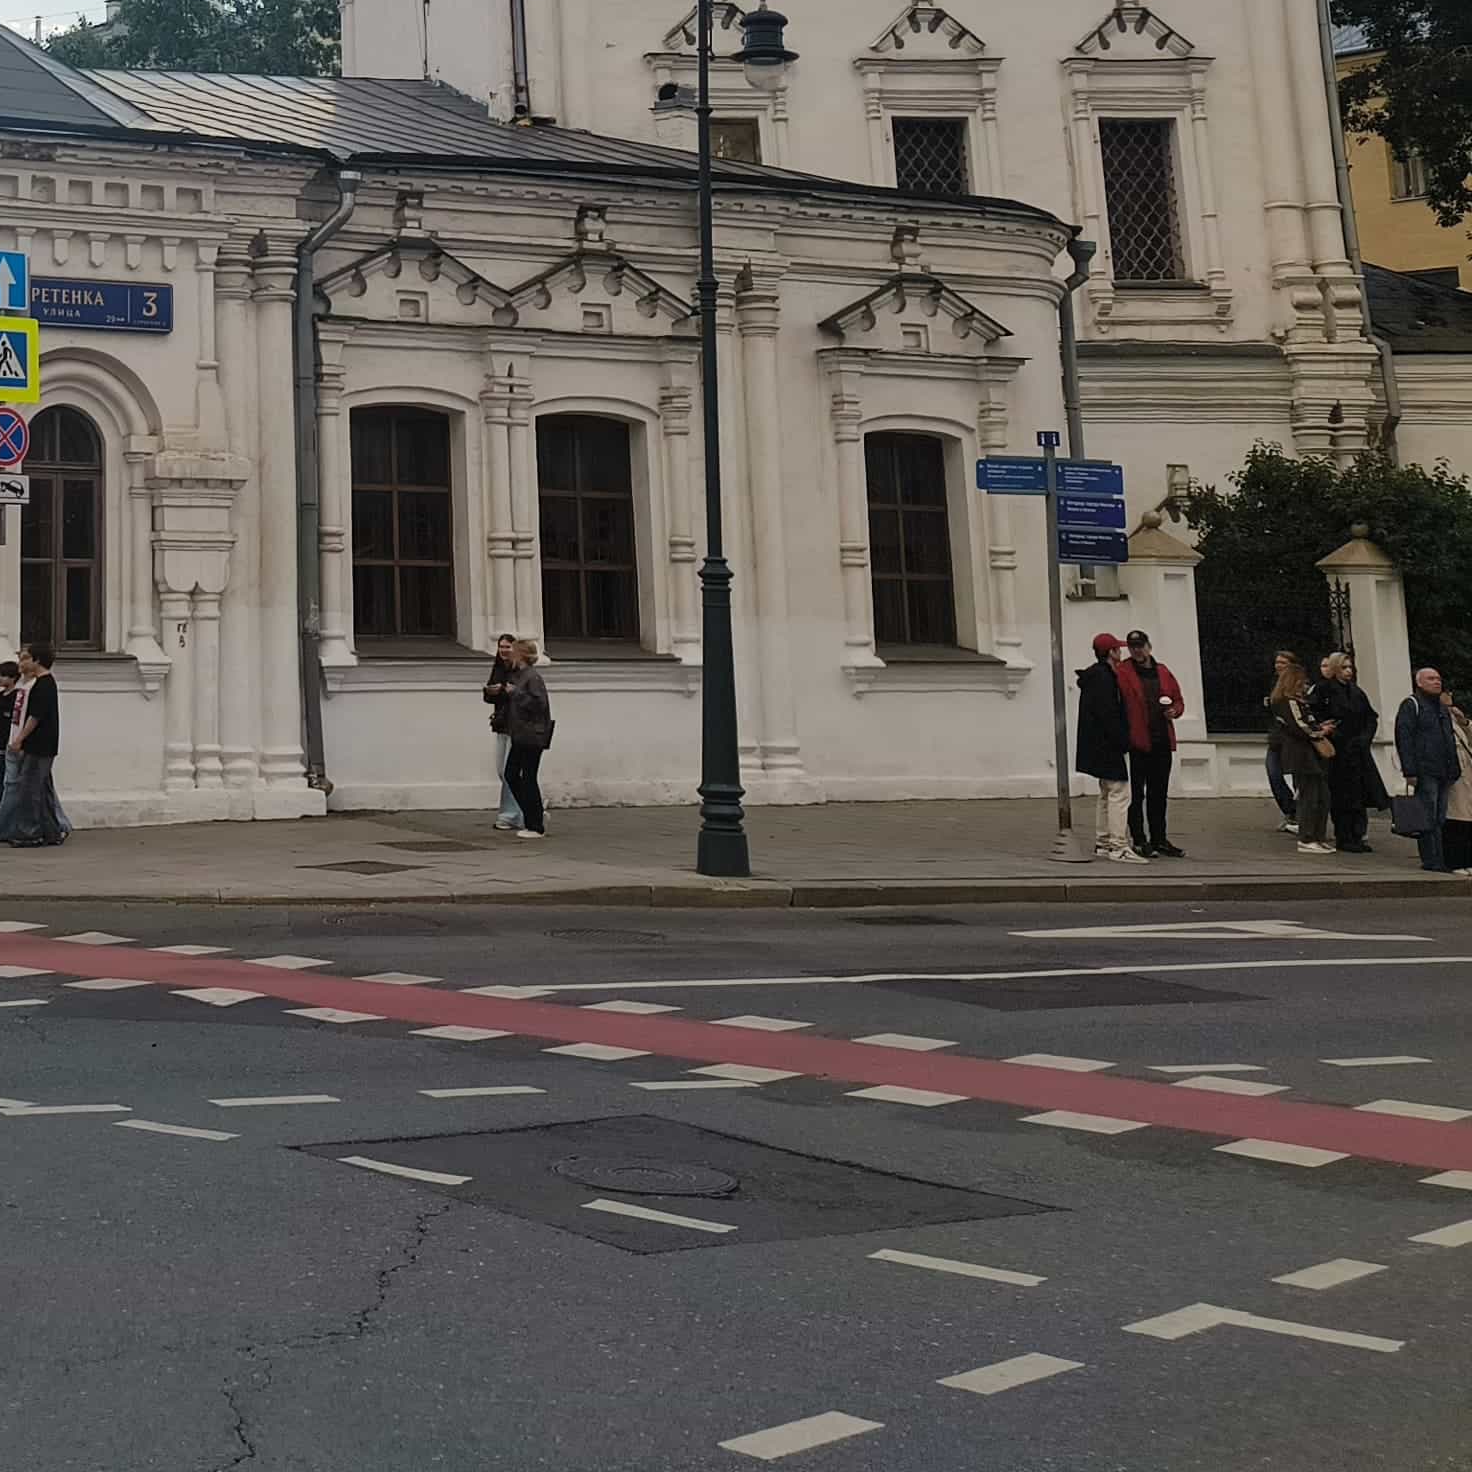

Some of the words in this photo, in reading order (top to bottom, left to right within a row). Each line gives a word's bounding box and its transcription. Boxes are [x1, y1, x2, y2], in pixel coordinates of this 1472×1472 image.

[31, 287, 104, 307] РЕТЕНКА
[142, 291, 158, 317] 3
[43, 307, 81, 319] УЛИЦА
